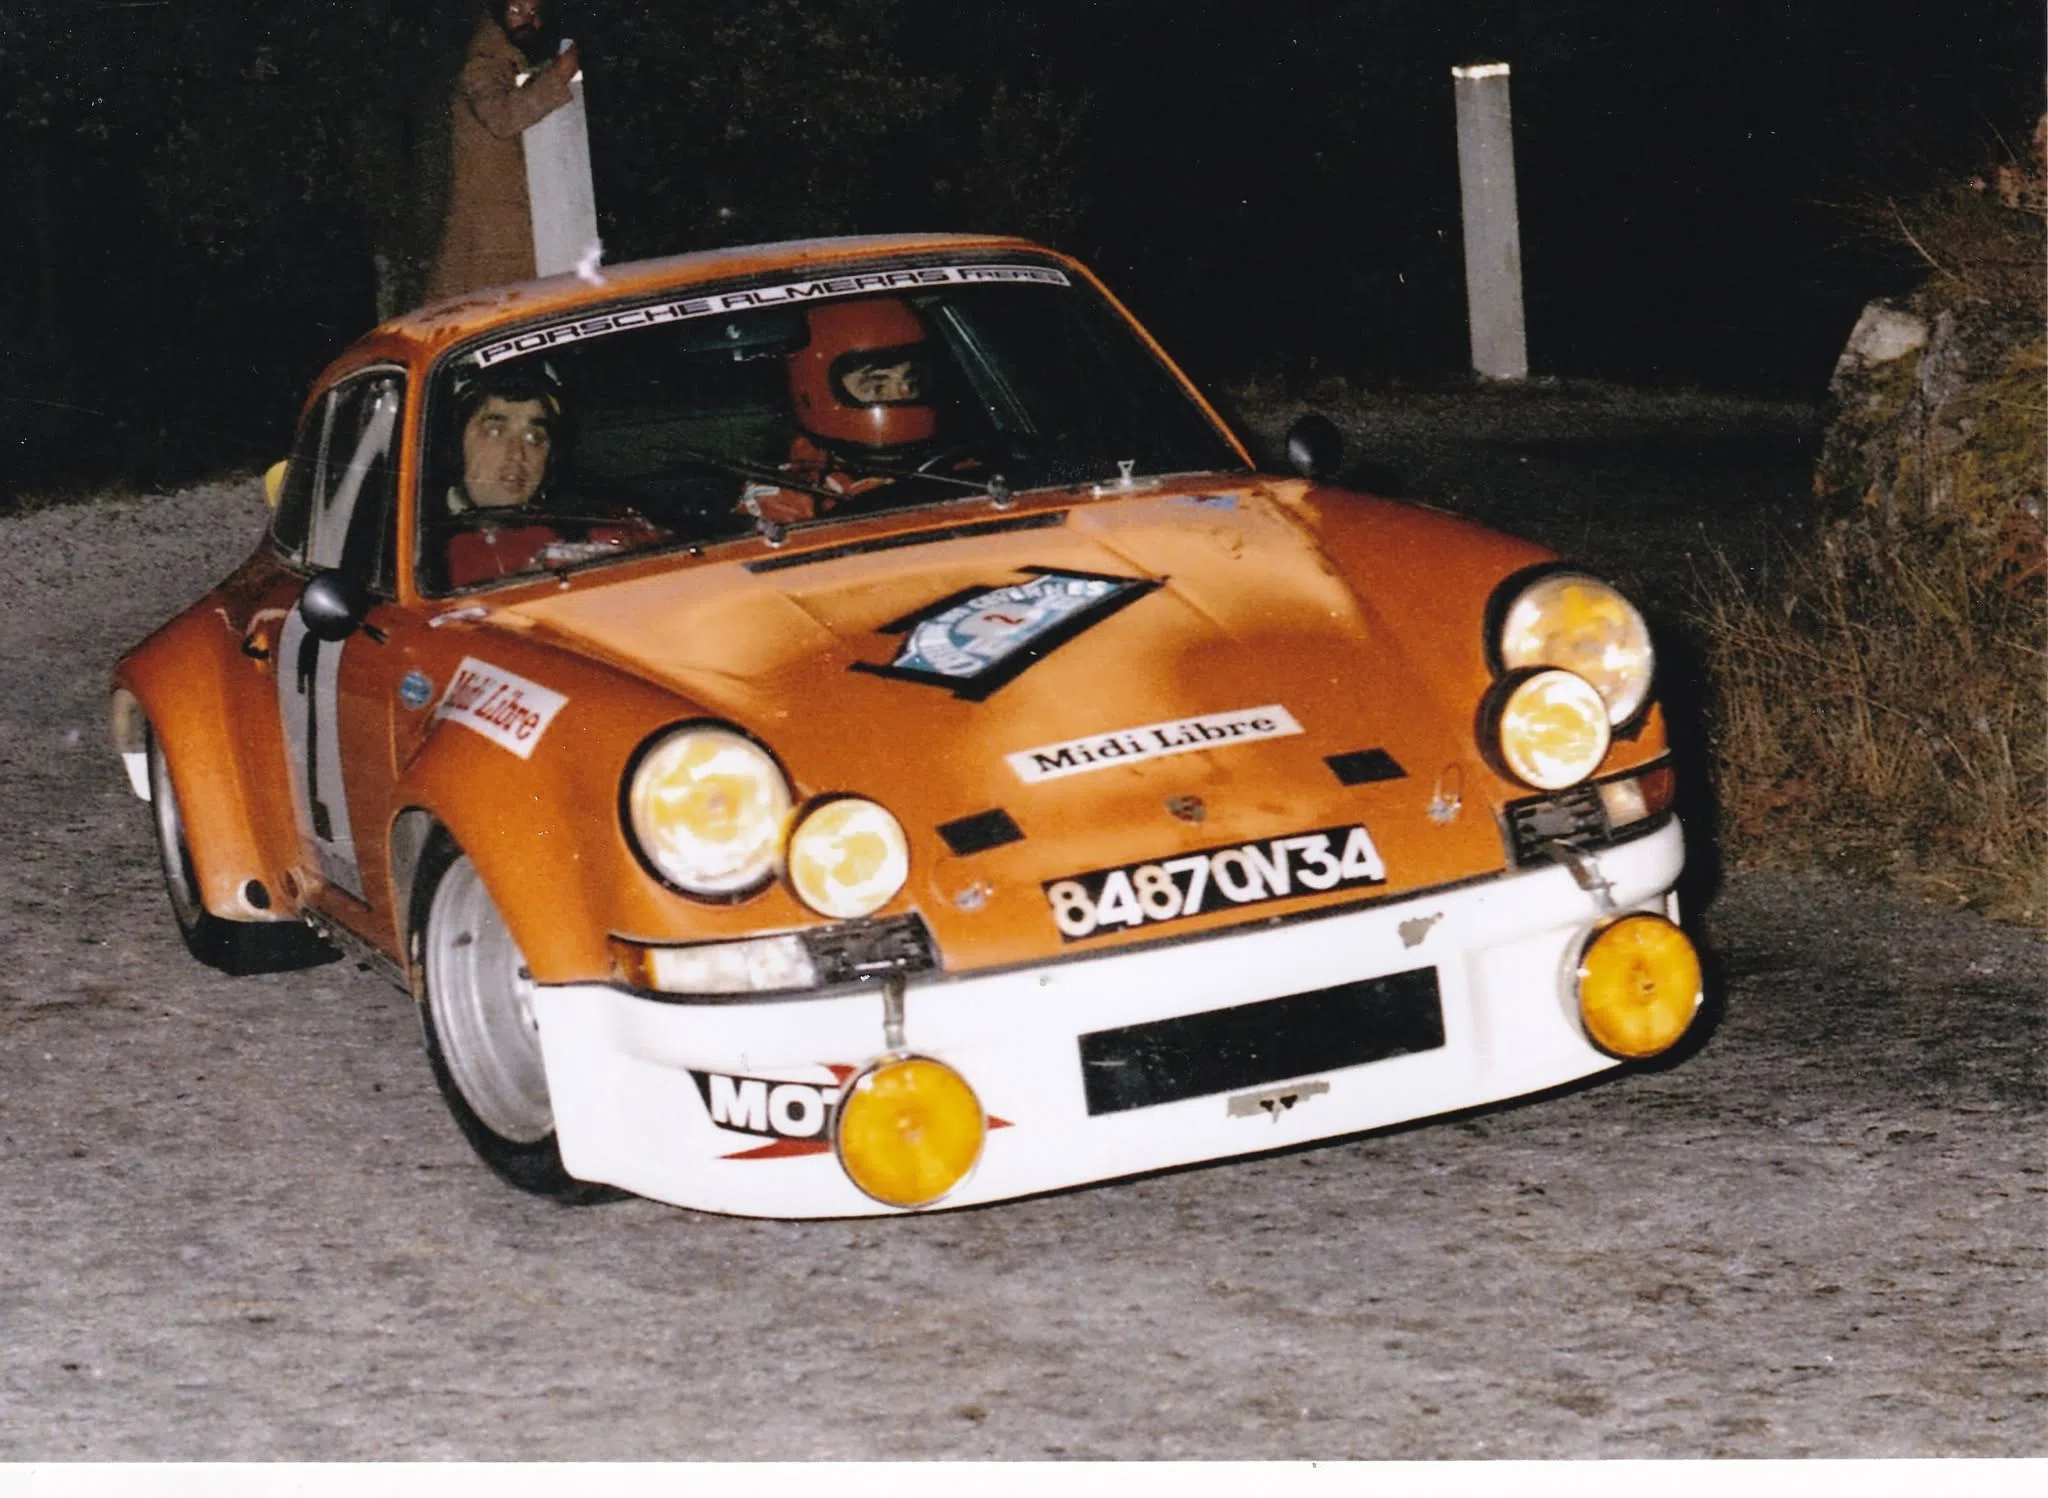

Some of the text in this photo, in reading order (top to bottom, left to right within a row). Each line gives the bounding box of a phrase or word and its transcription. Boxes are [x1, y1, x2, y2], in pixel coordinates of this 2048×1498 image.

[482, 298, 712, 365] PORSCHE
[721, 265, 951, 312] ALMERAS
[473, 683, 541, 741] Libre
[1032, 715, 1278, 773] Midi Libre
